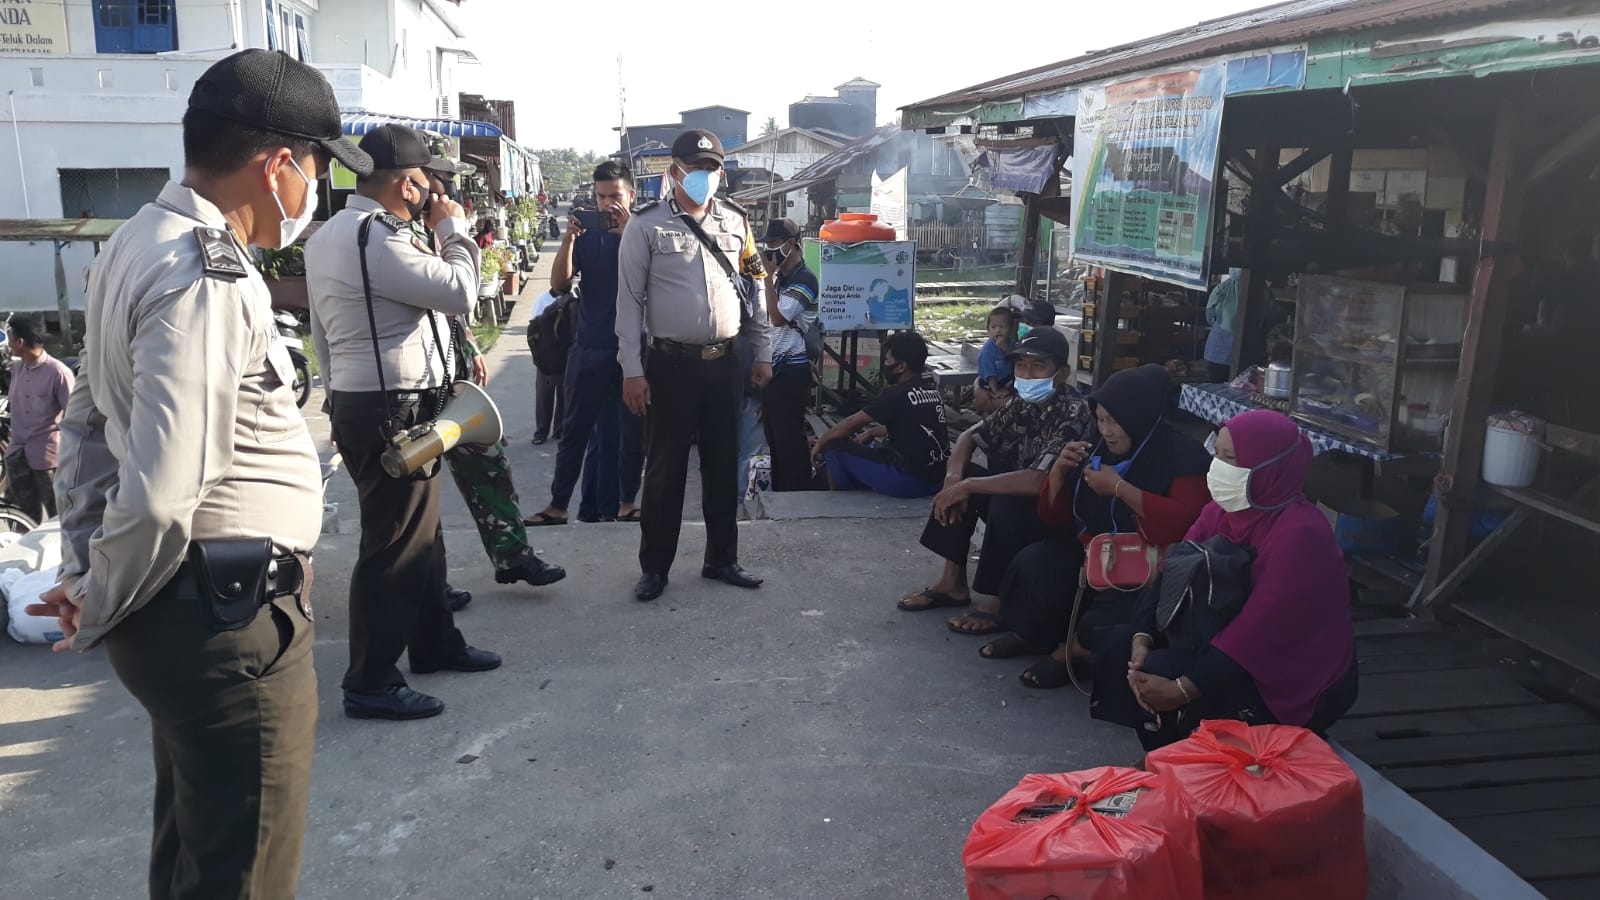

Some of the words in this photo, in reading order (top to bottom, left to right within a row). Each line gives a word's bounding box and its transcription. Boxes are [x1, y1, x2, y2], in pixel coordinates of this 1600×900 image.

[26, 33, 53, 45] Dalam
[211, 262, 244, 272] POLISI
[824, 284, 842, 293] Jaga
[842, 284, 855, 292] Diri
